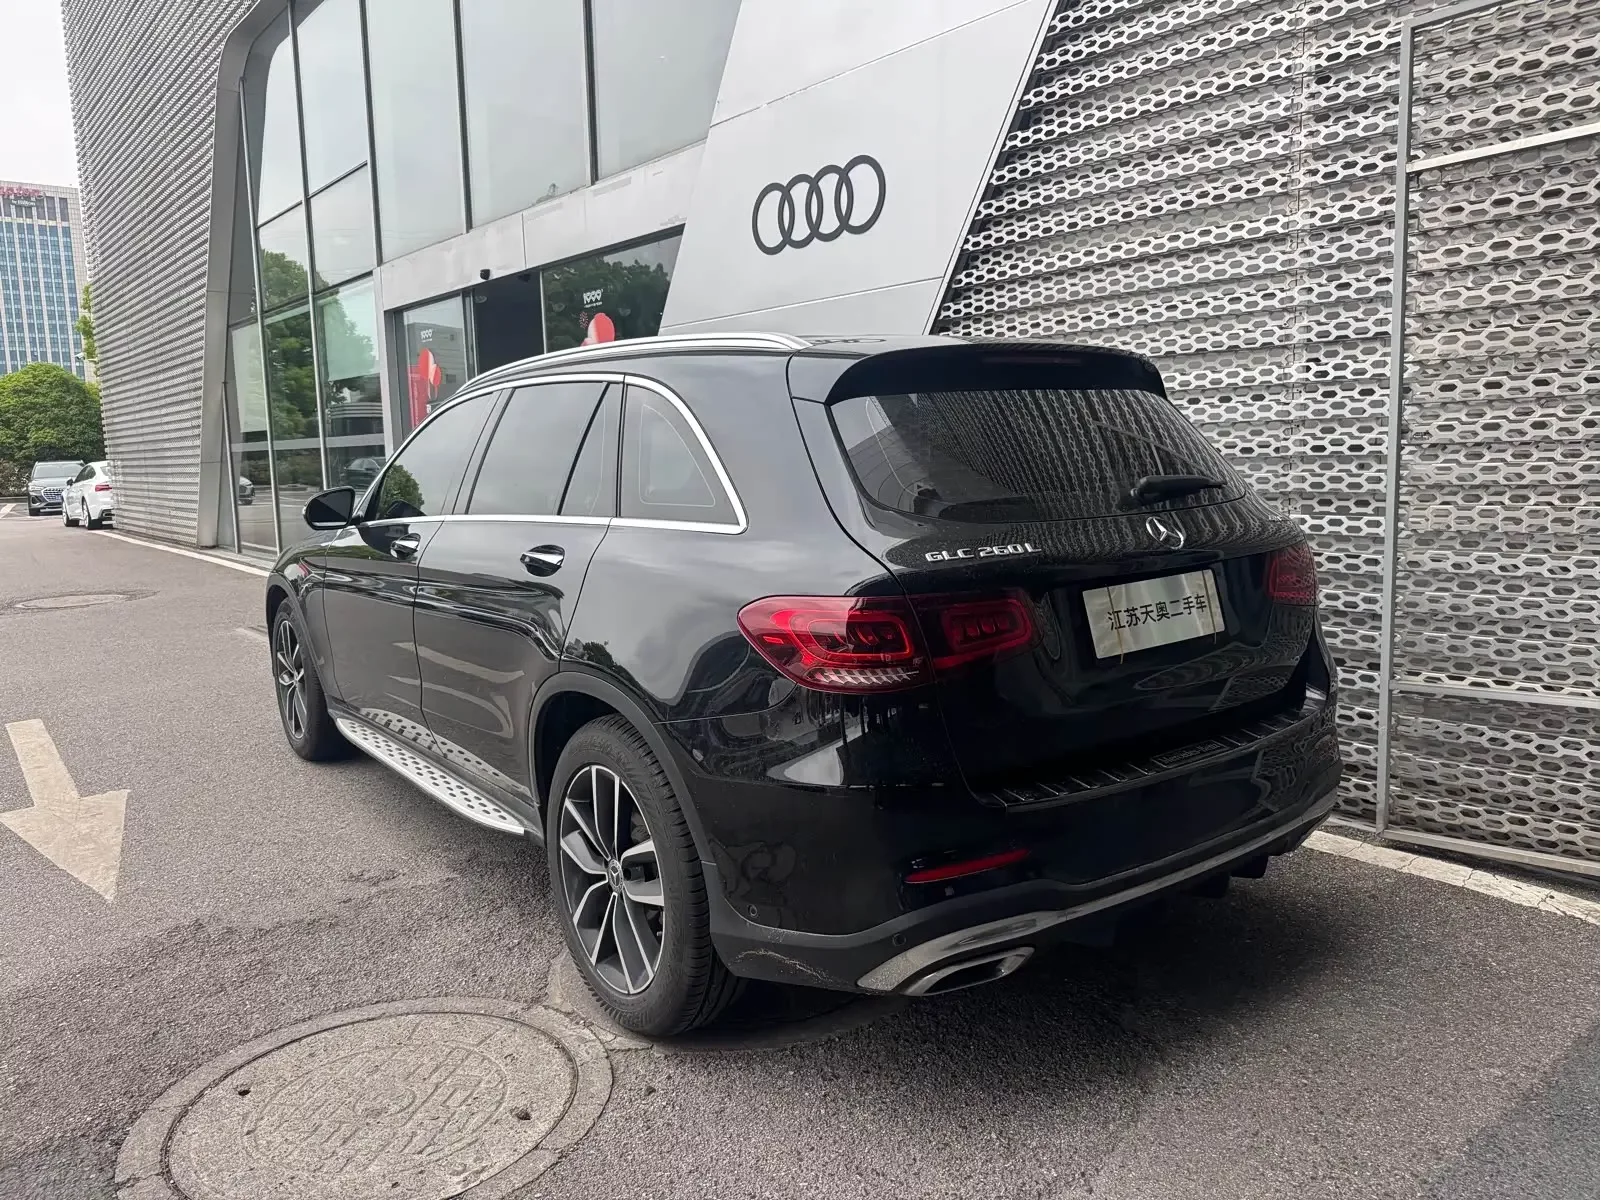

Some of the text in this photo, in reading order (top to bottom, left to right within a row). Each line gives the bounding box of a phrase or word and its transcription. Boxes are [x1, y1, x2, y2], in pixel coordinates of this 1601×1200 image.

[925, 547, 974, 562] GLC
[1107, 593, 1207, 631] 江苏天奥二手车
